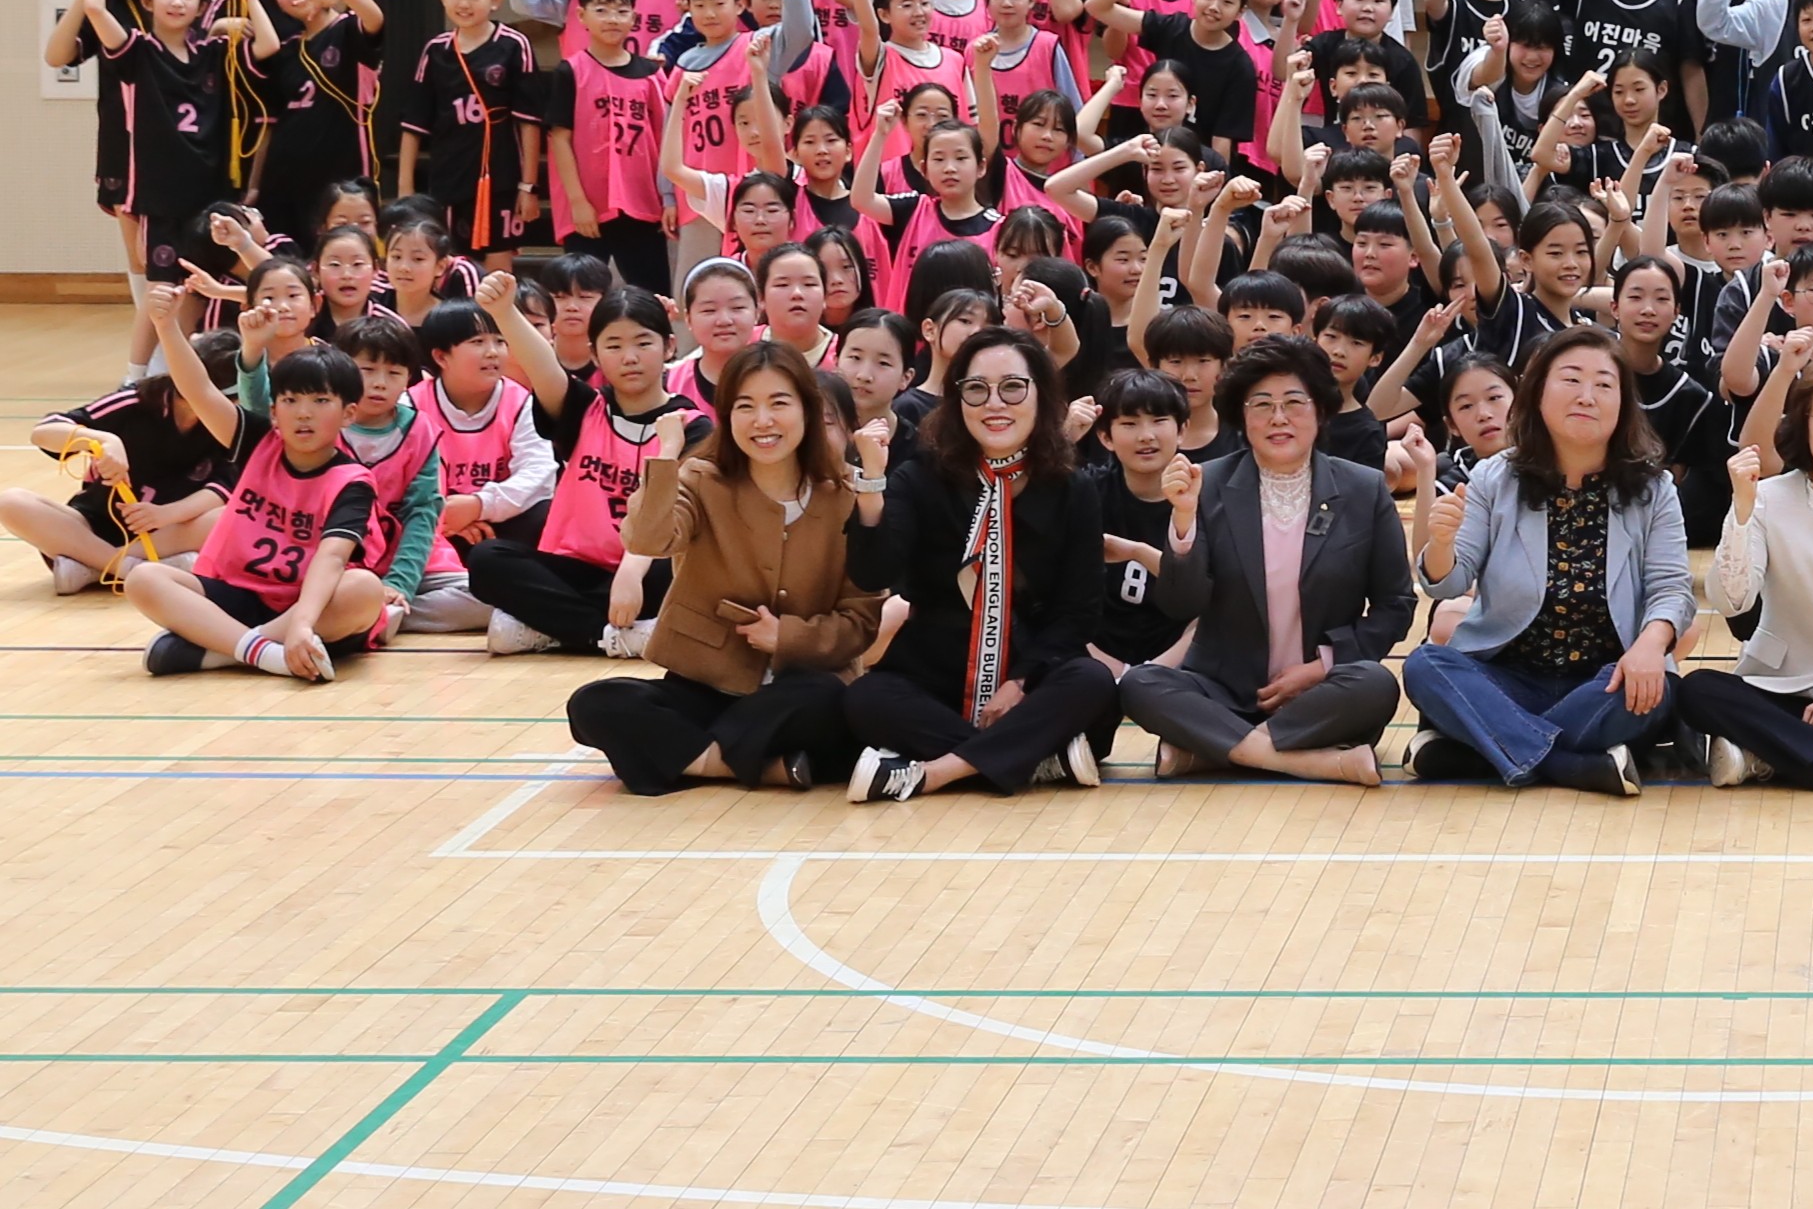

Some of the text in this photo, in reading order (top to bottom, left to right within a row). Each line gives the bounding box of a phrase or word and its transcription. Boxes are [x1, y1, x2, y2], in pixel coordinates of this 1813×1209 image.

[176, 103, 200, 134] 2
[593, 95, 653, 121] 멋진행
[691, 114, 725, 153] 30
[577, 454, 640, 496] 멋진행
[235, 487, 322, 541] 멋진행
[987, 498, 1000, 566] ONDON
[243, 537, 306, 584] 23
[1120, 560, 1149, 605] 8
[984, 571, 1001, 649] ENGLAND
